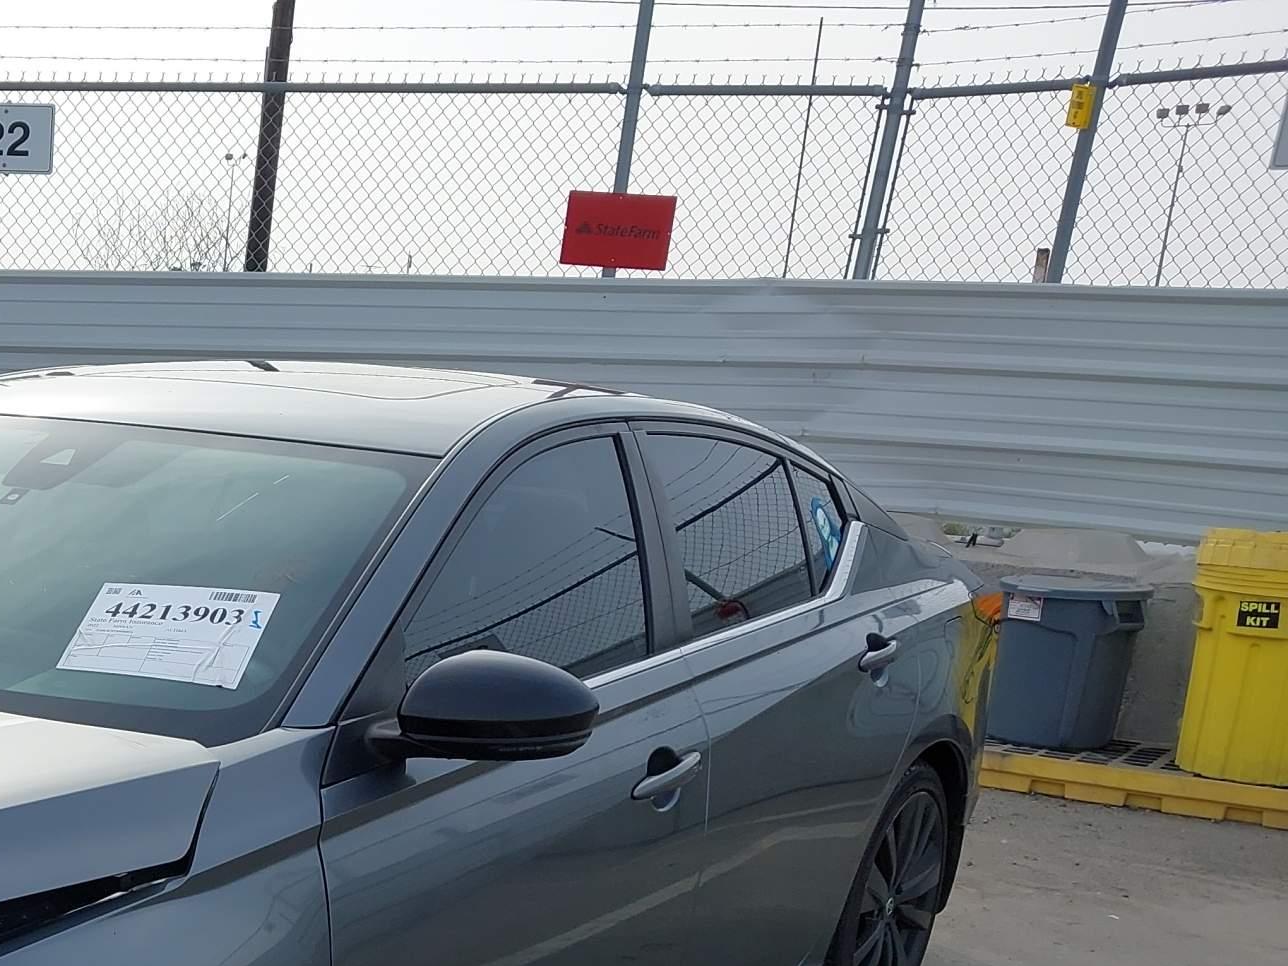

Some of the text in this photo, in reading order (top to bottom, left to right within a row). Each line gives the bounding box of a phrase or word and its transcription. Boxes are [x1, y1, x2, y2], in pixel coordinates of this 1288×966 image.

[105, 601, 245, 625] 44213903
[1240, 602, 1279, 613] SPILL
[1245, 615, 1270, 627] KIT
